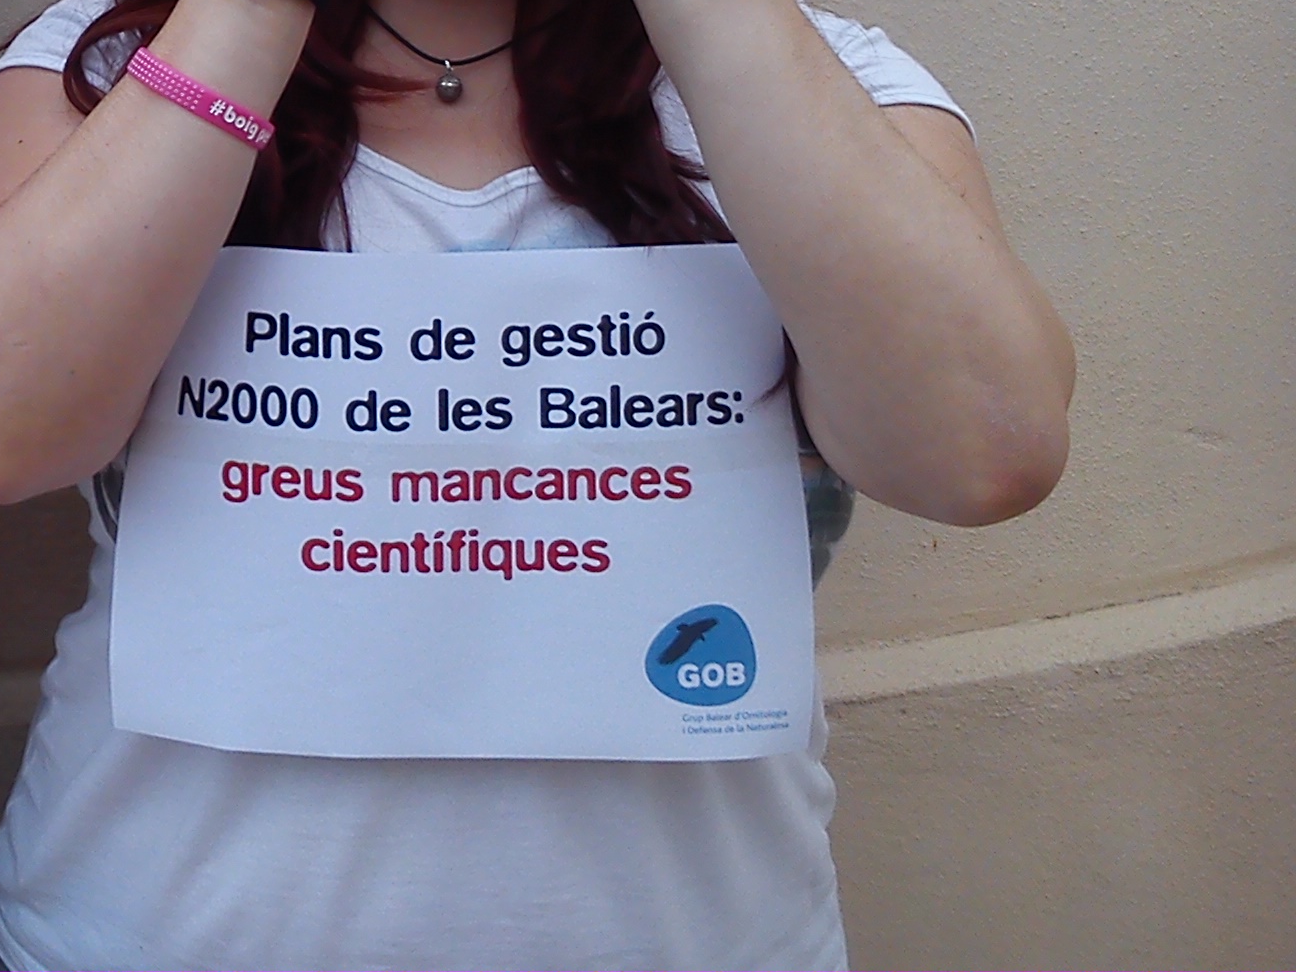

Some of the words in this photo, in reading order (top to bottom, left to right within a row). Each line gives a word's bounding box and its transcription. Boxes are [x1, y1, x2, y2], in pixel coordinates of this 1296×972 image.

[209, 99, 271, 143] #boig
[245, 311, 383, 361] Plans
[410, 318, 476, 362] de
[501, 310, 666, 368] gestió
[178, 375, 319, 430] N2000
[345, 389, 412, 433] de
[438, 388, 513, 432] les
[539, 384, 745, 430] Balears:
[221, 460, 364, 504] greus
[391, 464, 693, 503] mancances
[301, 529, 611, 581] científiques
[677, 661, 746, 689] GOB
